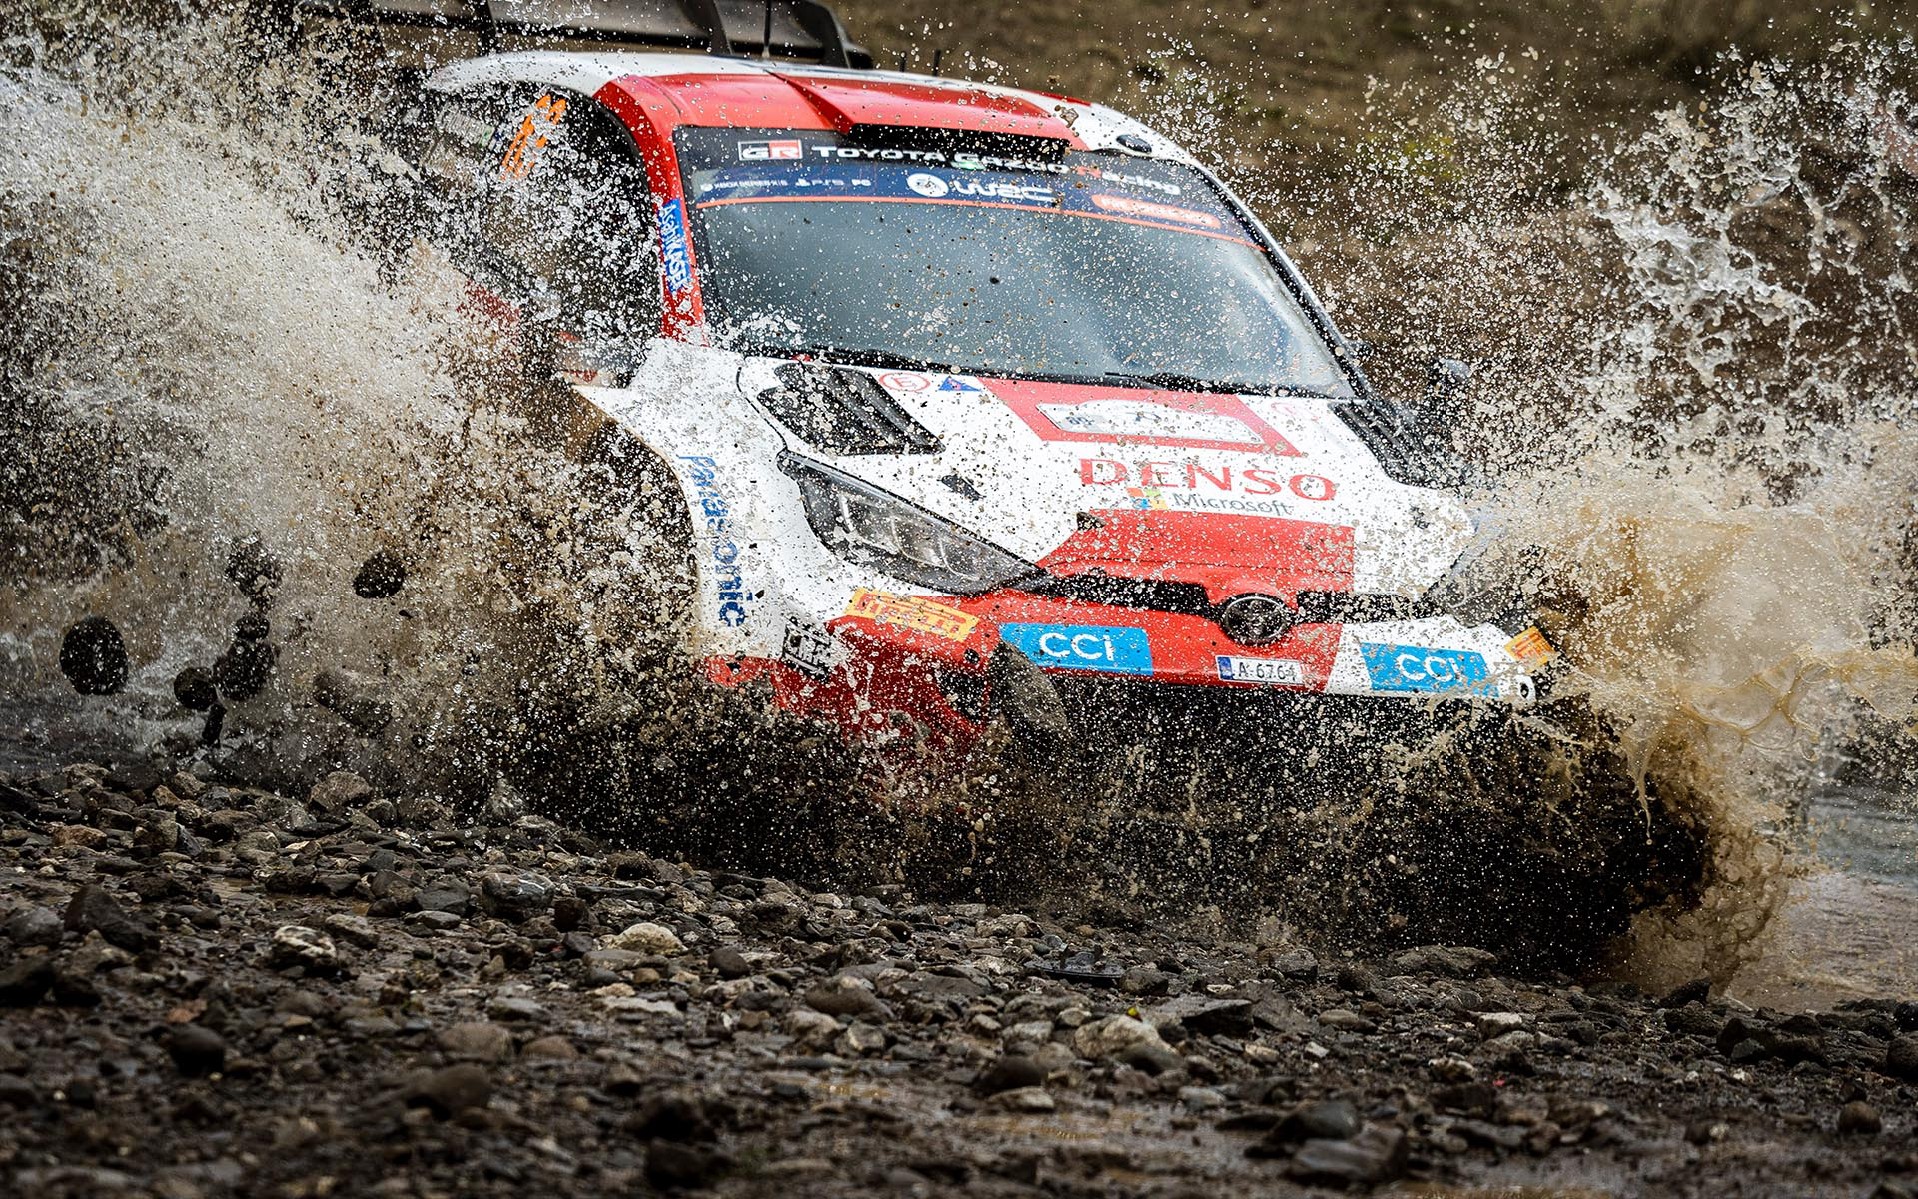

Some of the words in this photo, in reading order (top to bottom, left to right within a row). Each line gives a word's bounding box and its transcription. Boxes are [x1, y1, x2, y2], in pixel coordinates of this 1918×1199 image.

[742, 146, 799, 160] GR
[811, 145, 946, 162] TOYOTA
[952, 179, 1057, 202] WRC
[1078, 457, 1337, 501] DENSO
[1171, 492, 1294, 516] Microsoft
[678, 455, 754, 628] Panasonic
